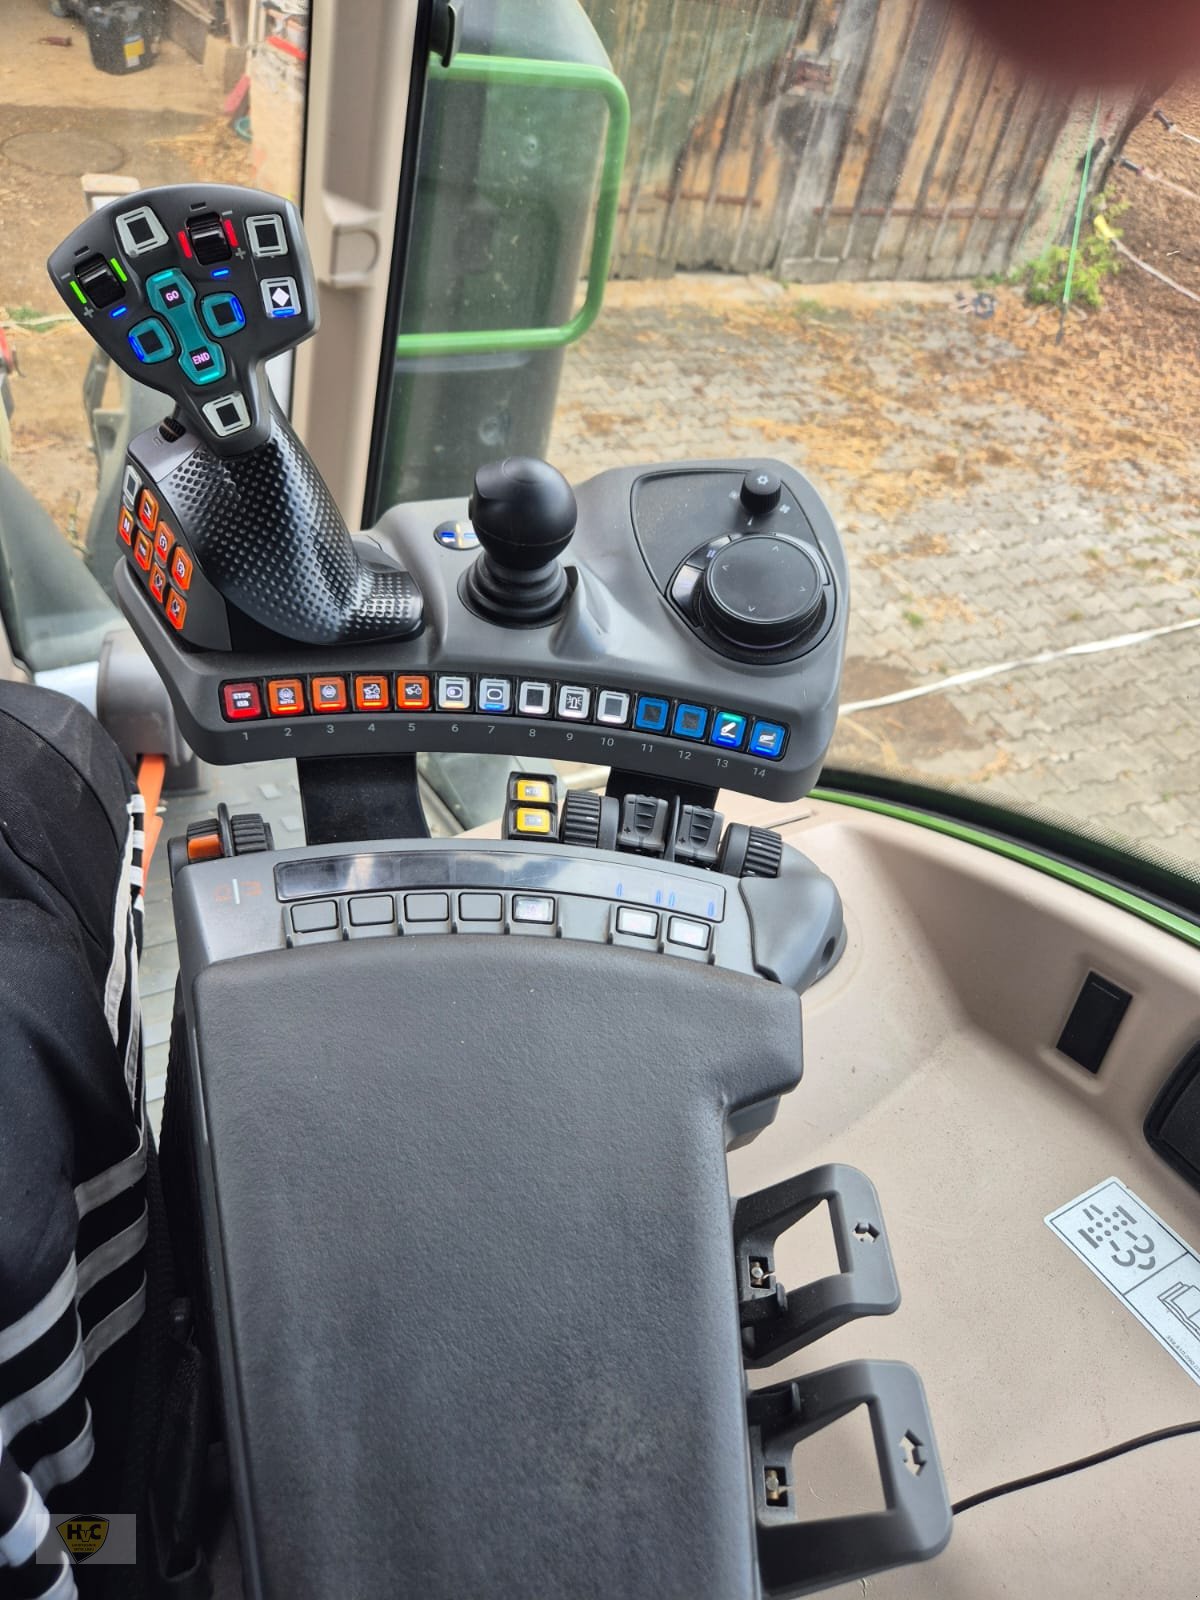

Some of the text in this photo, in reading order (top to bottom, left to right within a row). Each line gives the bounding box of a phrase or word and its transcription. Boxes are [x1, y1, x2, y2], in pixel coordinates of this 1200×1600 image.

[165, 290, 180, 302] GO
[192, 352, 210, 365] END
[242, 723, 766, 778] 1 2 3 4 5 6 7 8 9 10 11 12 13 14
